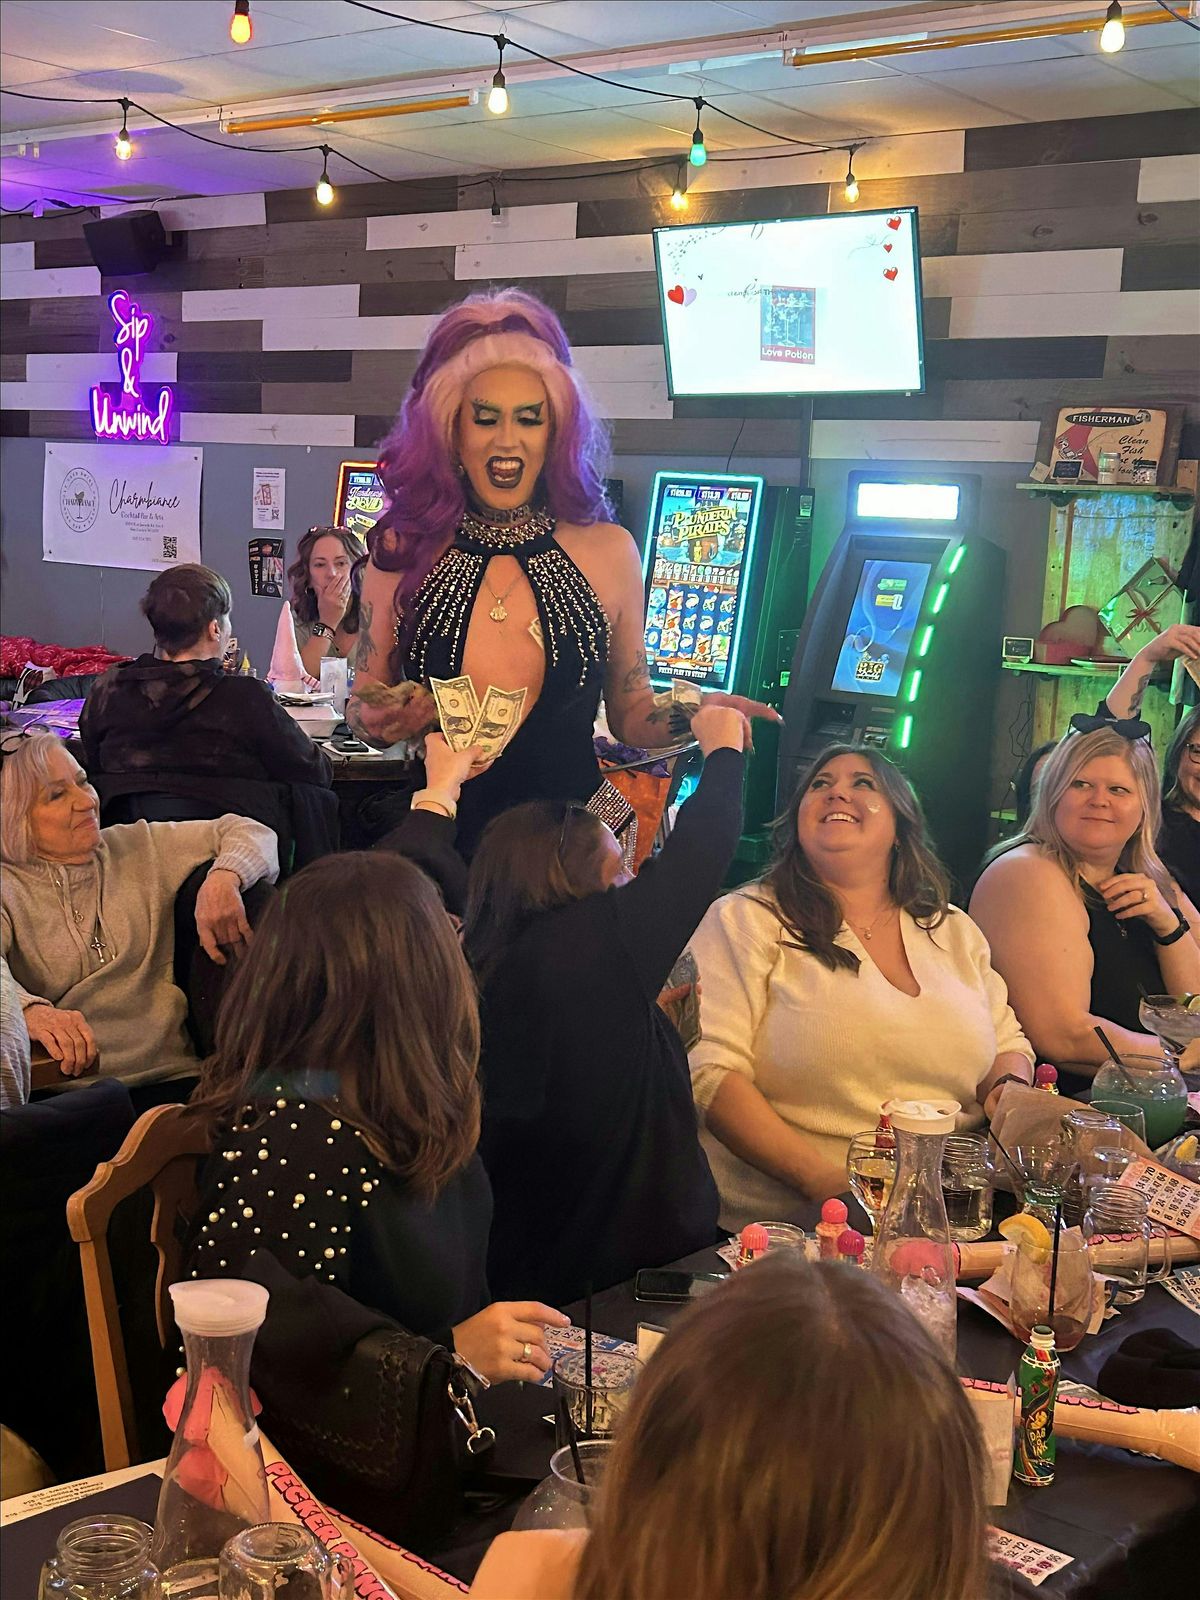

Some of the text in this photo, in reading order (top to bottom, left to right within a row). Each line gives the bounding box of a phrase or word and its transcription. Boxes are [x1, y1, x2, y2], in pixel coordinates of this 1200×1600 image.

[110, 291, 149, 361] Sip
[762, 348, 814, 360] Love Potion
[121, 349, 139, 397] &
[91, 389, 169, 441] Unwind
[1072, 415, 1131, 424] FISHERMAN
[1118, 435, 1149, 445] Clean
[1121, 446, 1144, 455] Fish
[109, 478, 180, 514] Charmbiance
[1144, 1166, 1155, 1176] 70
[1180, 1208, 1191, 1218] 20
[1185, 1278, 1197, 1286] 15
[1171, 1285, 1183, 1293] 14
[264, 1461, 342, 1546] PECKER
